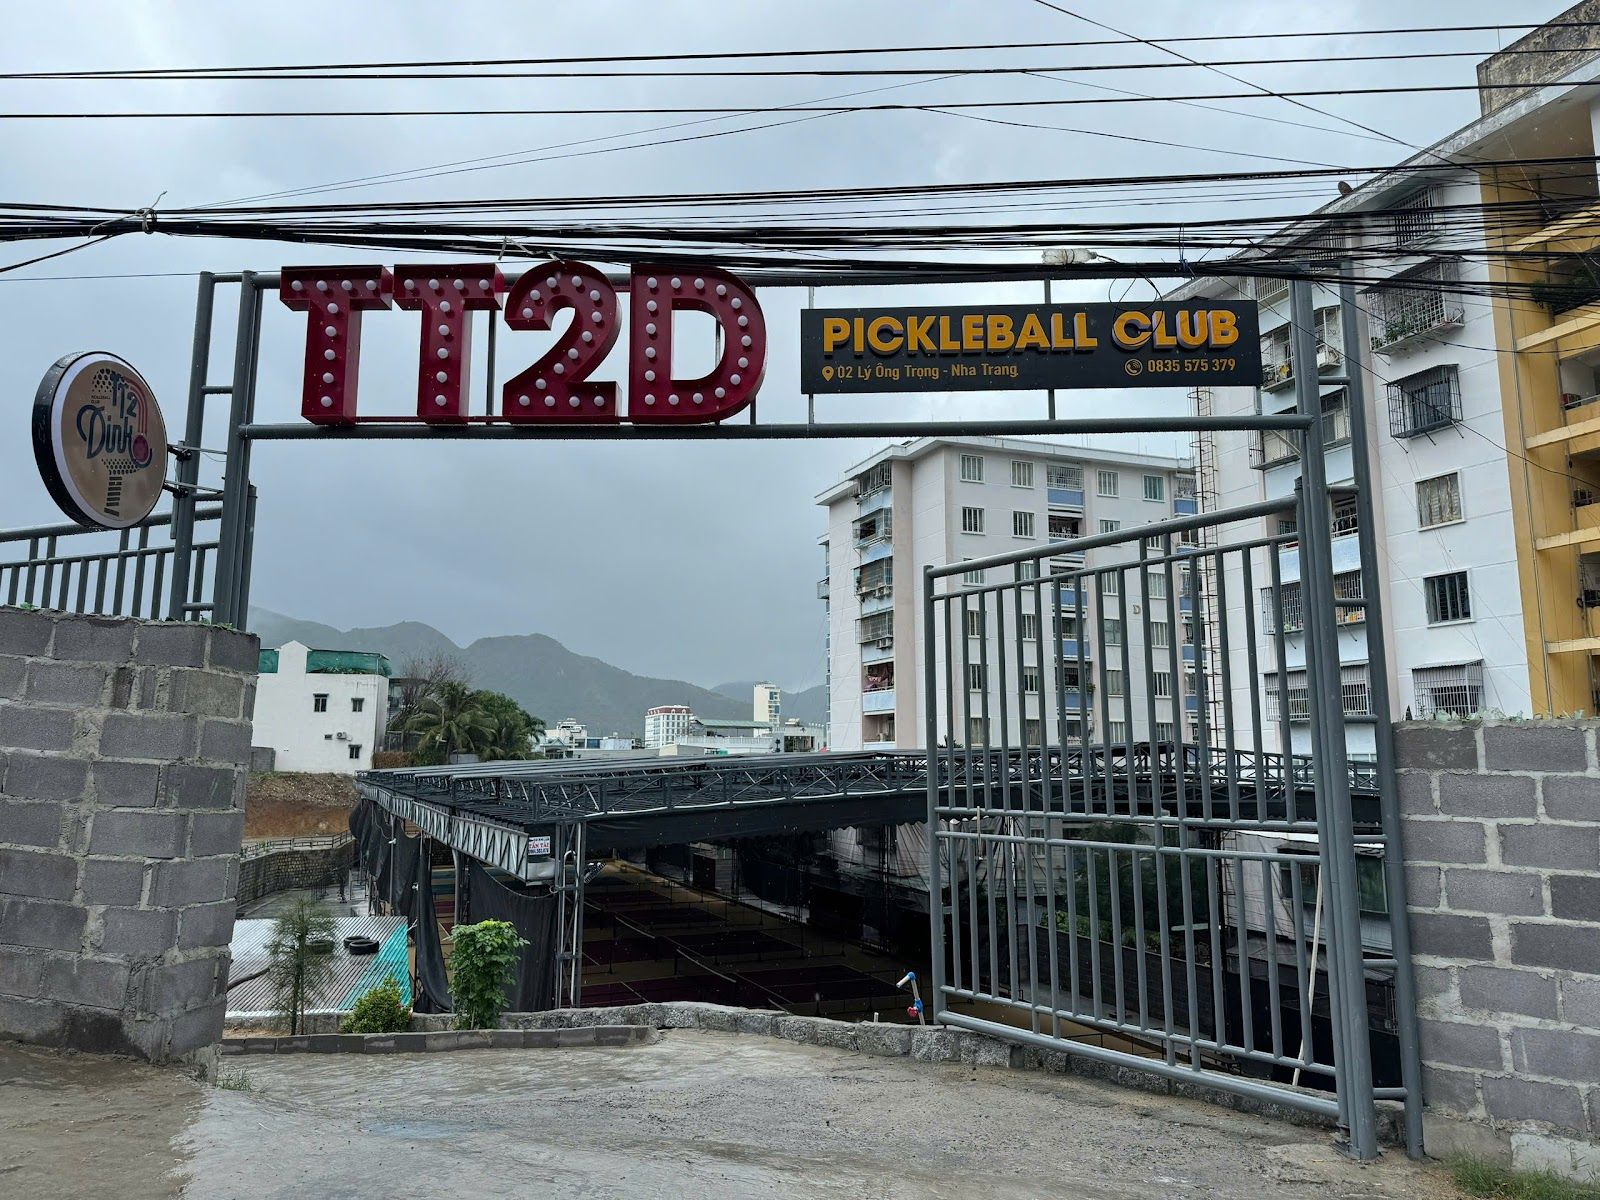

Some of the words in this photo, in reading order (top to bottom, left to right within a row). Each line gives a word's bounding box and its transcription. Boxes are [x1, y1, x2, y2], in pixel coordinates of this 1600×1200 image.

[280, 260, 766, 425] TT2D
[822, 313, 1098, 355] PICKLEBALL
[1112, 309, 1240, 350] CLUB
[837, 365, 853, 378] 02
[857, 364, 872, 380] Lý
[875, 362, 900, 380] Ông
[904, 364, 939, 380] Trọng
[951, 364, 977, 377] Nha
[981, 363, 1018, 378] Trang
[1147, 359, 1180, 372] 0835
[1184, 359, 1209, 372] 575
[1212, 358, 1236, 371] 379
